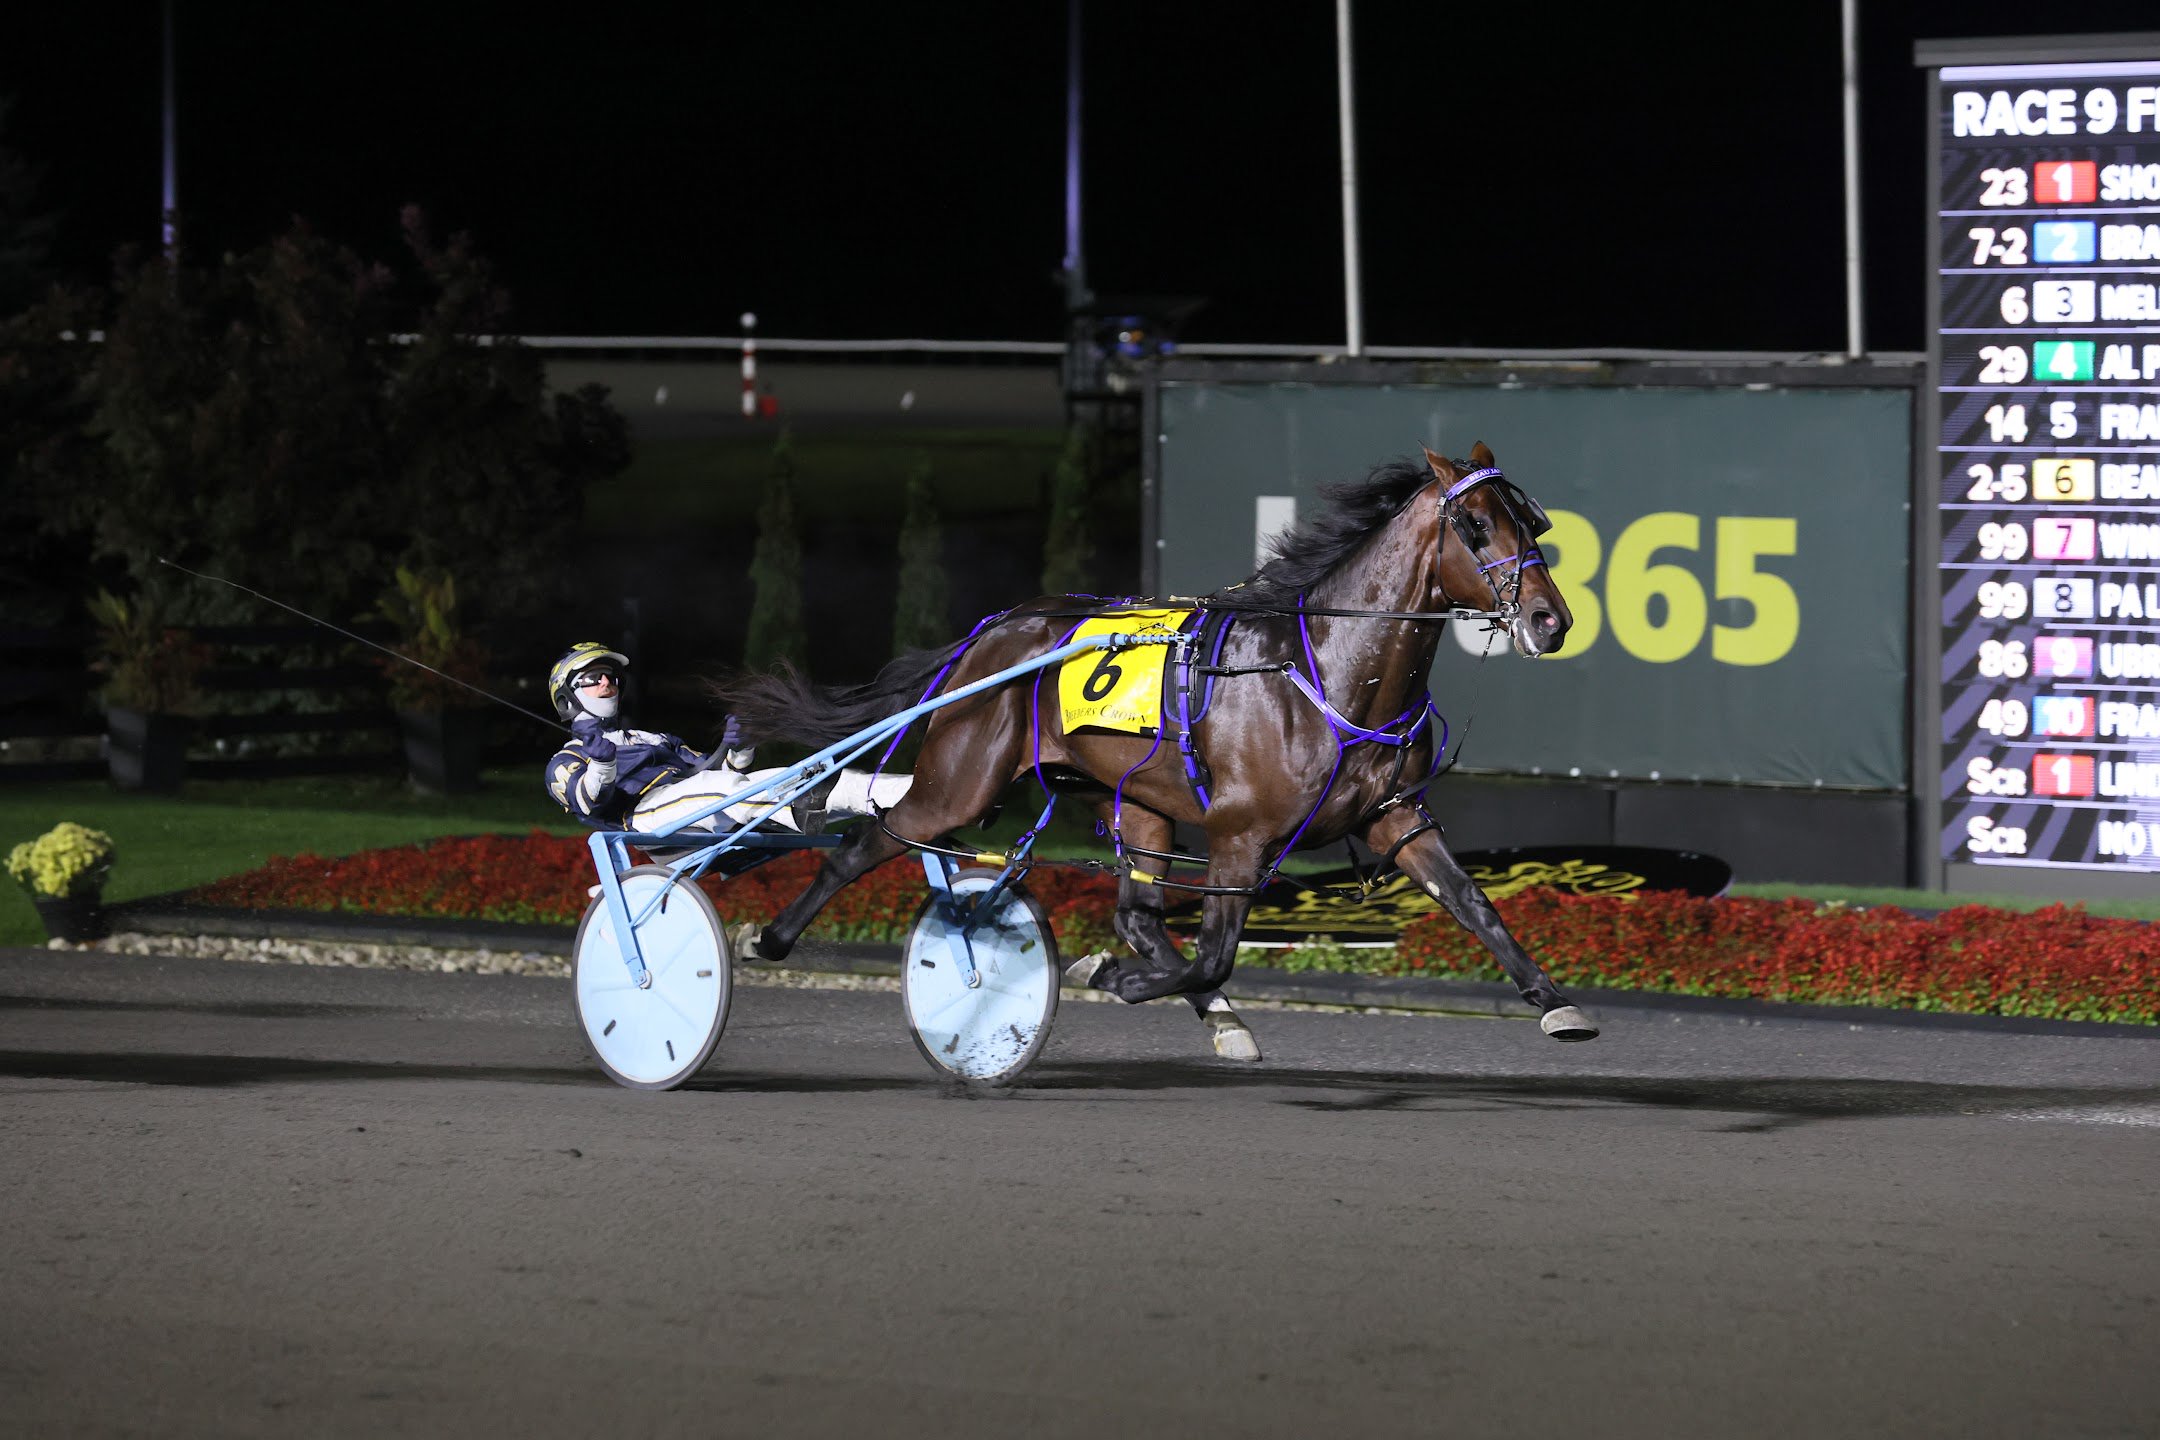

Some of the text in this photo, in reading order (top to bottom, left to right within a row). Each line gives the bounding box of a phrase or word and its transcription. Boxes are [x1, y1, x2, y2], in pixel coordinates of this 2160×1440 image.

[1953, 88, 2077, 137] RACE
[2084, 88, 2117, 135] 9
[1979, 167, 2028, 207] 23
[2051, 163, 2073, 202] 1
[1968, 227, 2028, 265] 7-2
[2050, 223, 2079, 261] 2
[2000, 285, 2029, 325] 6
[2056, 286, 2073, 317] 3
[1978, 345, 2029, 384] 29
[2049, 341, 2078, 380] 4
[1984, 401, 2160, 442] 14 5 FRA
[1967, 463, 2160, 501] 2-5 6 BEA
[1977, 522, 2028, 561] 99
[2056, 524, 2073, 557] 7
[1977, 581, 2028, 619] 99
[2054, 583, 2074, 613] 8
[1083, 632, 1122, 702] 6
[1977, 639, 2028, 678] 86
[2050, 637, 2078, 677] 9
[1977, 698, 2160, 737] 49 10 FRA
[2050, 757, 2072, 795] 1
